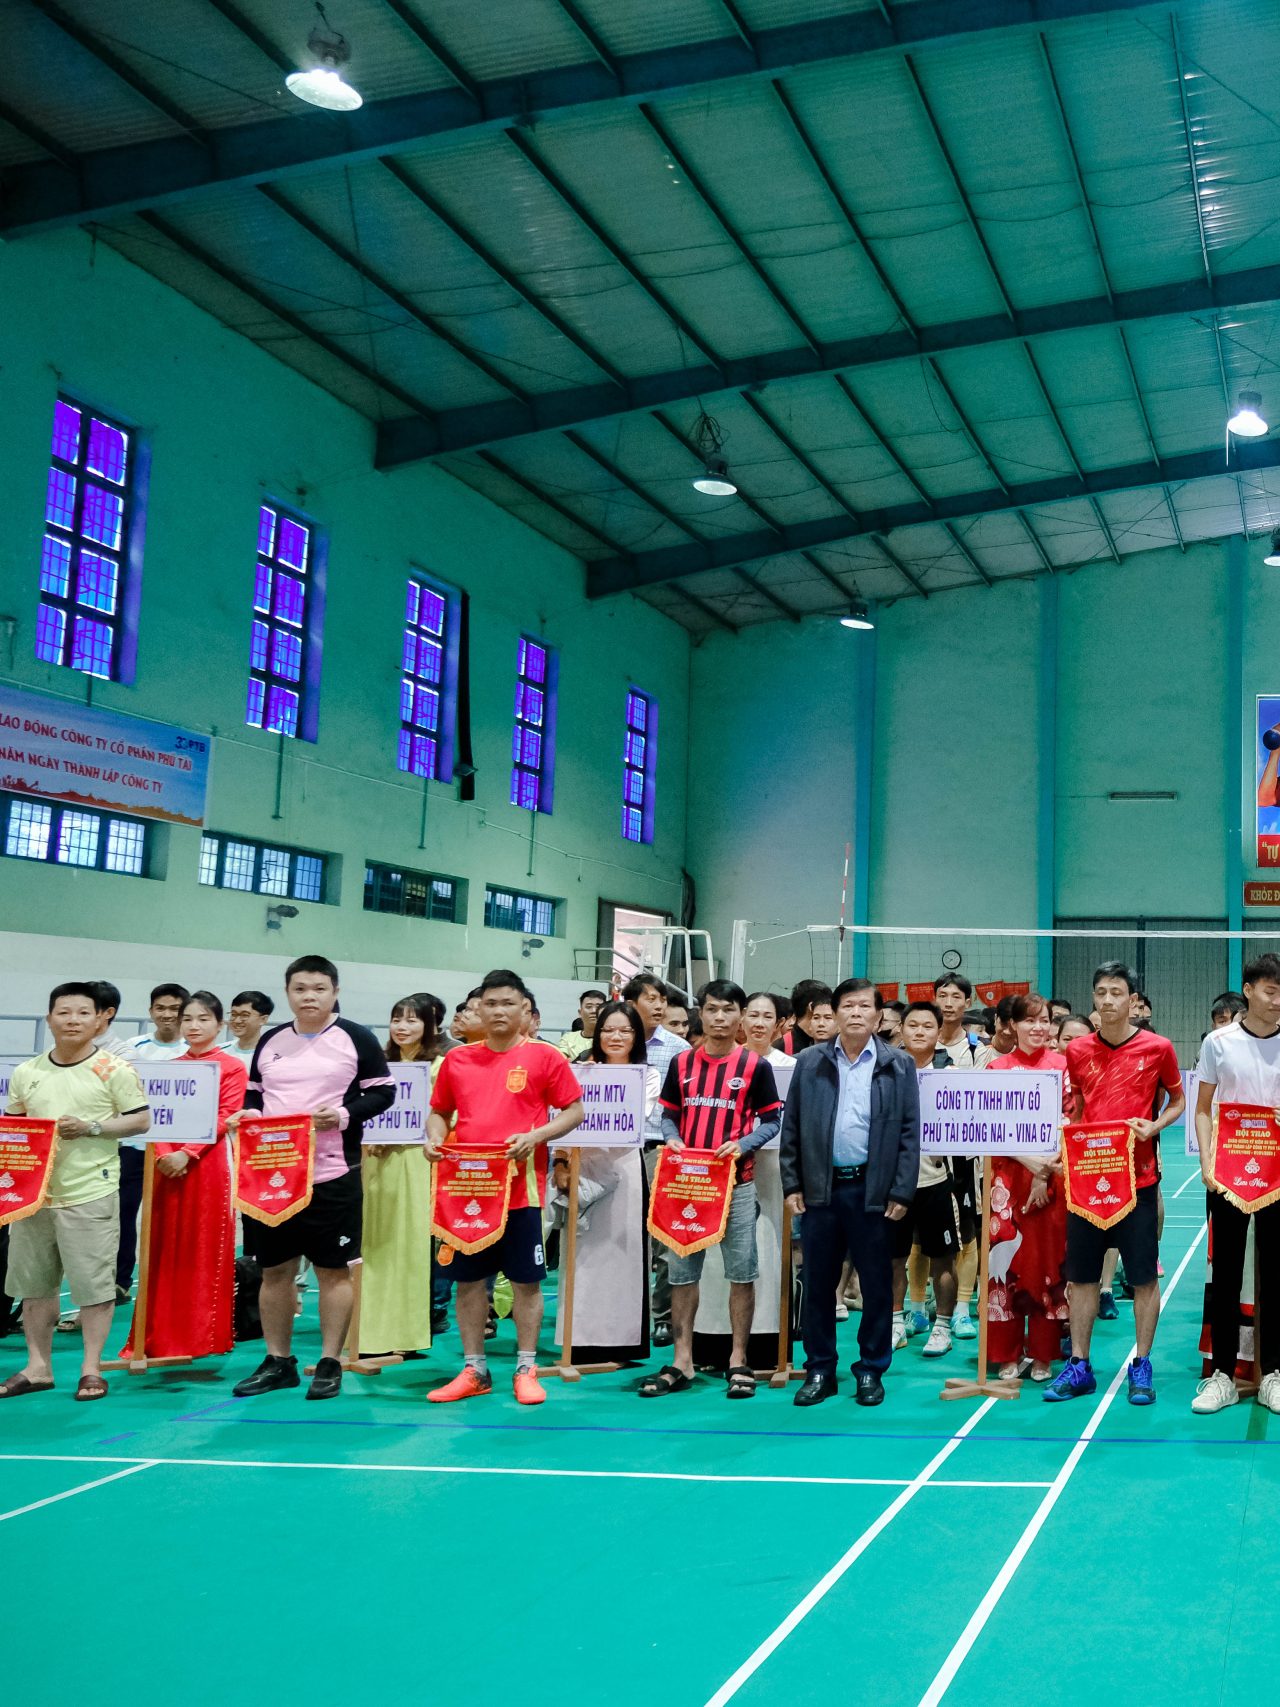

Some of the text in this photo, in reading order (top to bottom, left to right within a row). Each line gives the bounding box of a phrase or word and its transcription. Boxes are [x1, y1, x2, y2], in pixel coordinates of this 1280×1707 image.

[24, 719, 57, 738] ĐỘNG
[61, 728, 93, 747] CÔNG
[96, 737, 108, 751] TY
[28, 753, 60, 770] NGÀY
[63, 761, 100, 778] THÀNH
[122, 774, 149, 790] CÔNG
[152, 781, 163, 793] TY
[149, 1077, 196, 1100] KHU VỰC
[400, 1081, 413, 1100] TY
[604, 1085, 626, 1102] MTV
[936, 1083, 1040, 1111] CÔNG TY TNHH MTV GỖ
[154, 1104, 173, 1125] YÊN
[379, 1106, 400, 1129] PHÚ
[405, 1106, 421, 1129] TÀI
[614, 1108, 634, 1131] HÒA
[923, 1118, 941, 1142] PHÚ
[945, 1118, 959, 1142] TÀI
[962, 1115, 987, 1142] ĐỒNG
[990, 1123, 1006, 1142] NAI
[1016, 1124, 1037, 1142] VINA
[1040, 1124, 1052, 1142] G7
